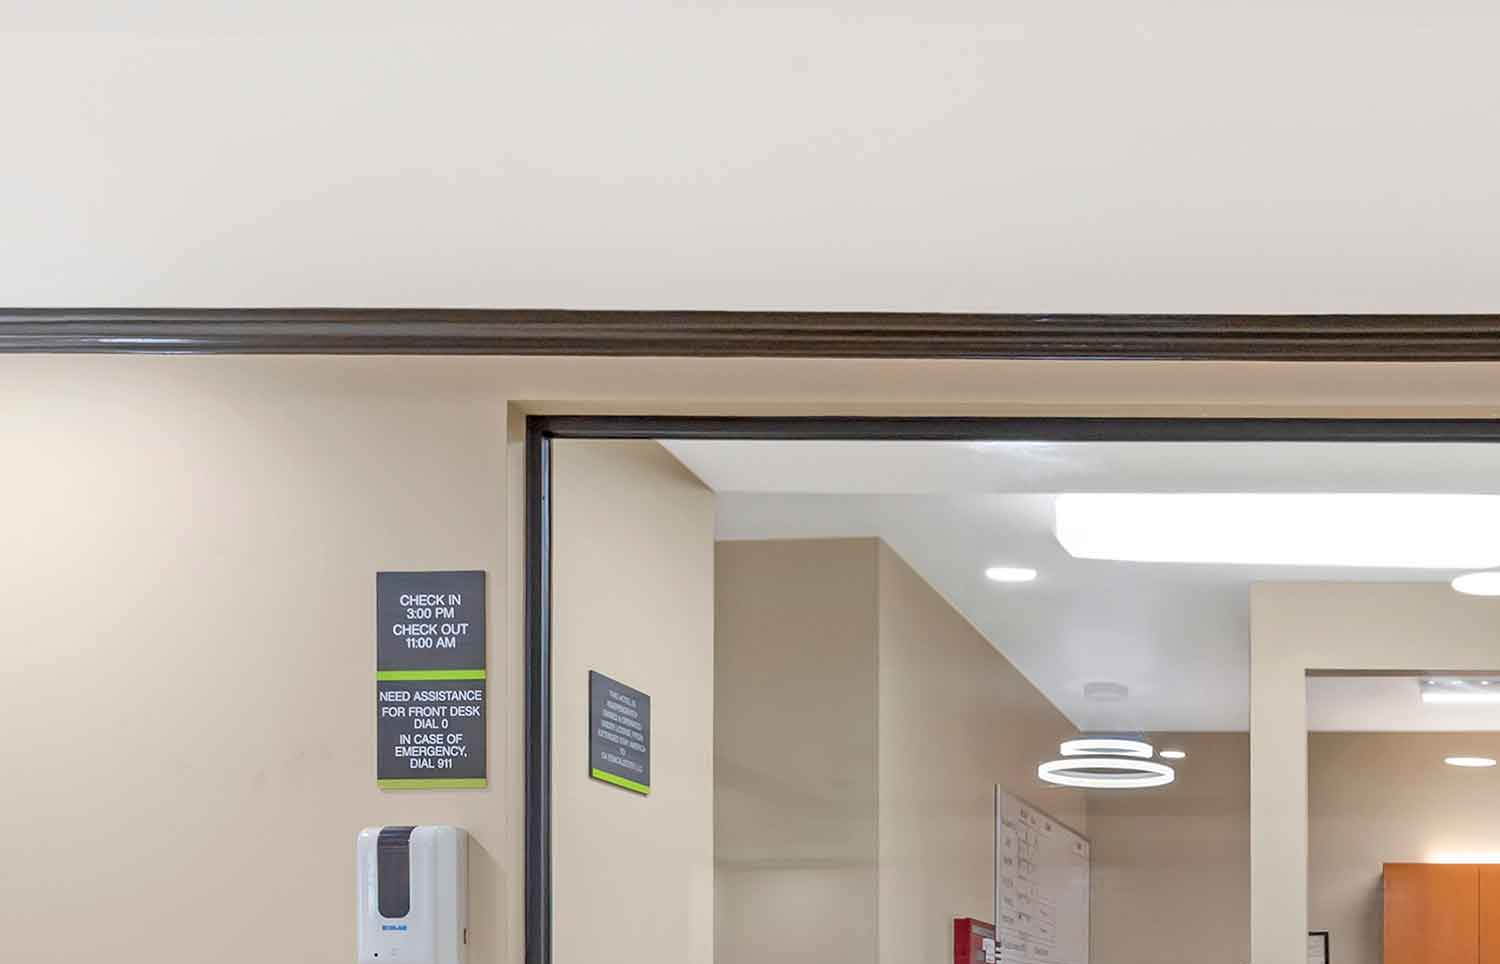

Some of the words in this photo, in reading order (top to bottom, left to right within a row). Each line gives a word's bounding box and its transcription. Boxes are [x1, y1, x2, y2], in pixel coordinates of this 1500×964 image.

[399, 594, 446, 606] CHECK
[448, 594, 462, 606] IN
[406, 607, 432, 619] 3:00
[435, 607, 455, 619] PM
[392, 623, 438, 636] CHECK
[440, 623, 469, 635] OUT
[405, 637, 433, 649] 11:00
[435, 637, 456, 649] AM
[379, 691, 411, 702] NEED
[413, 690, 483, 702] ASSISTANCE
[381, 706, 406, 718] FOR
[408, 706, 448, 717] FRONT
[450, 705, 481, 717] DESK
[413, 718, 439, 729] DIAL
[441, 718, 449, 729] 0
[399, 734, 411, 745] IN
[413, 734, 444, 745] CASE
[446, 733, 463, 745] OF
[394, 745, 468, 758] EMERGENCY,
[409, 758, 435, 769] DIAL
[437, 758, 453, 769] 911
